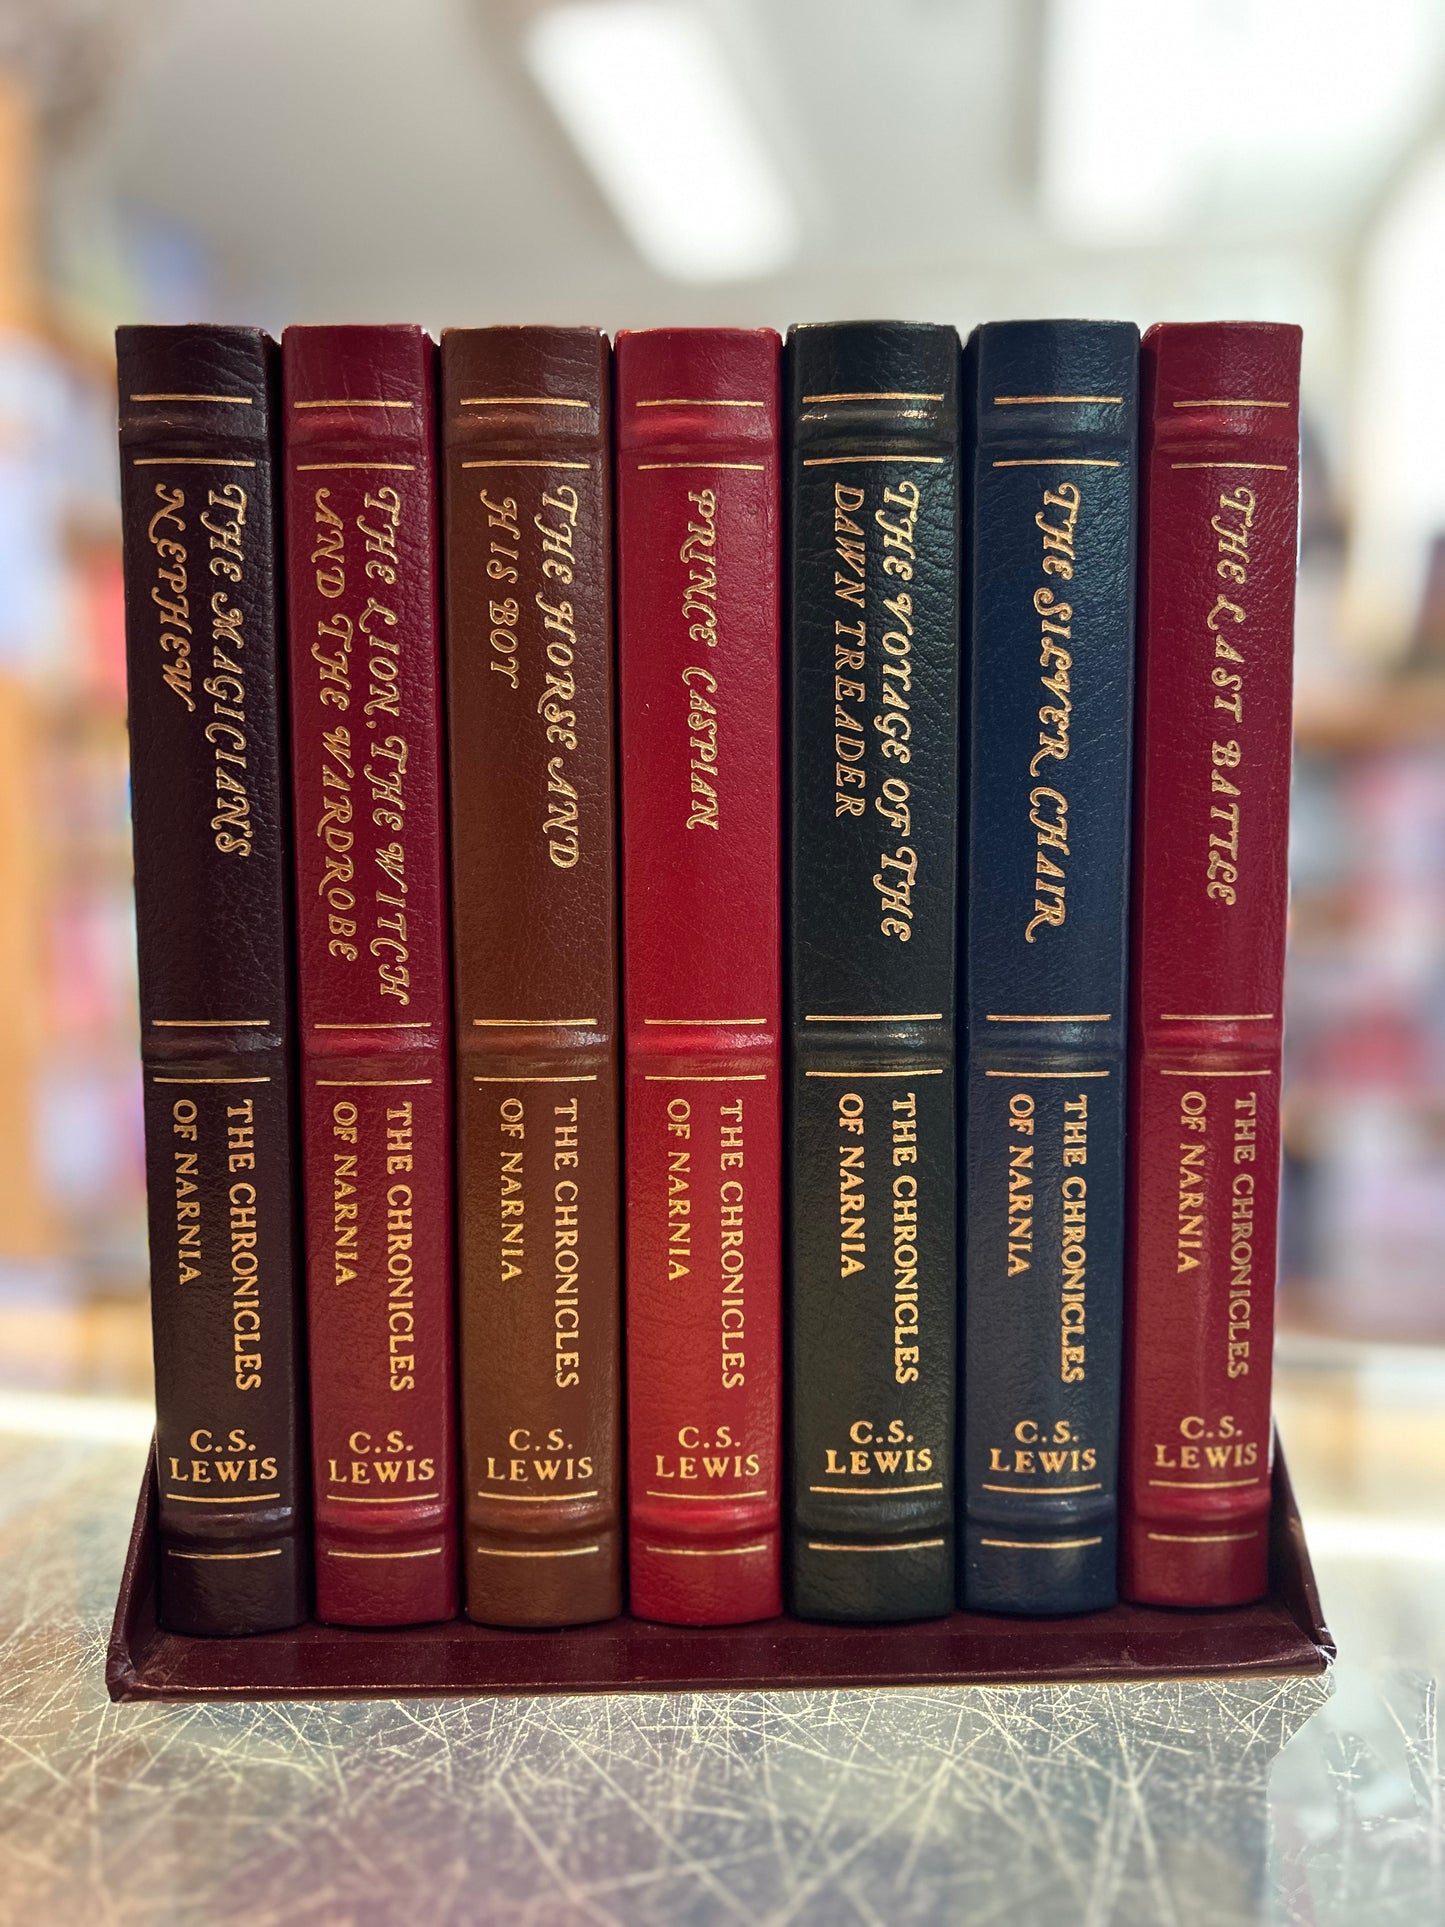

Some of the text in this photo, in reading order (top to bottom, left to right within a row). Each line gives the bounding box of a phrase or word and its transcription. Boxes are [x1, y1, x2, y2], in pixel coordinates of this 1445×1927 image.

[148, 484, 196, 712] NEPHEW
[202, 484, 252, 857] THE MAGICIAN'S
[480, 488, 521, 689] HIS BOY
[534, 484, 579, 869] THE HORSE AND
[680, 488, 719, 831] PRINCE CASPIAN
[834, 482, 866, 818] DAWN TREADER
[873, 481, 920, 942] THE VOYAGE OF THE
[1025, 482, 1081, 943] THE SILVER CHAIR
[1206, 486, 1256, 906] THE LAST BATTLE
[311, 487, 358, 962] AND THE WARDROBE
[357, 486, 410, 1006] THE LION, THE WITCH
[173, 1099, 202, 1286] OF NARNIA
[227, 1098, 262, 1391] THE CHRONICLES
[333, 1102, 359, 1286] OF NARNIA
[386, 1102, 415, 1392] THE CHRONICLES
[500, 1098, 524, 1282] OF NARNIA
[554, 1098, 580, 1389] THE CHRONICLES
[666, 1098, 691, 1281] OF NARNIA
[720, 1098, 745, 1389] THE CHRONICLES
[838, 1093, 866, 1279] OF NARNIA
[892, 1092, 919, 1385] THE CHRONICLES
[1007, 1093, 1035, 1278] OF NARNIA
[1061, 1094, 1088, 1384] THE CHRONICLES
[1177, 1091, 1207, 1274] OF NARNIA
[1227, 1092, 1256, 1379] THE CHRONICLES
[169, 1456, 278, 1483] LEWIS
[328, 1457, 435, 1484] LEWIS
[486, 1456, 594, 1481] LEWIS
[656, 1454, 760, 1479] LEWIS
[825, 1448, 933, 1474] LEWIS
[989, 1448, 1097, 1474] LEWIS
[1154, 1443, 1258, 1469] LEWIS
